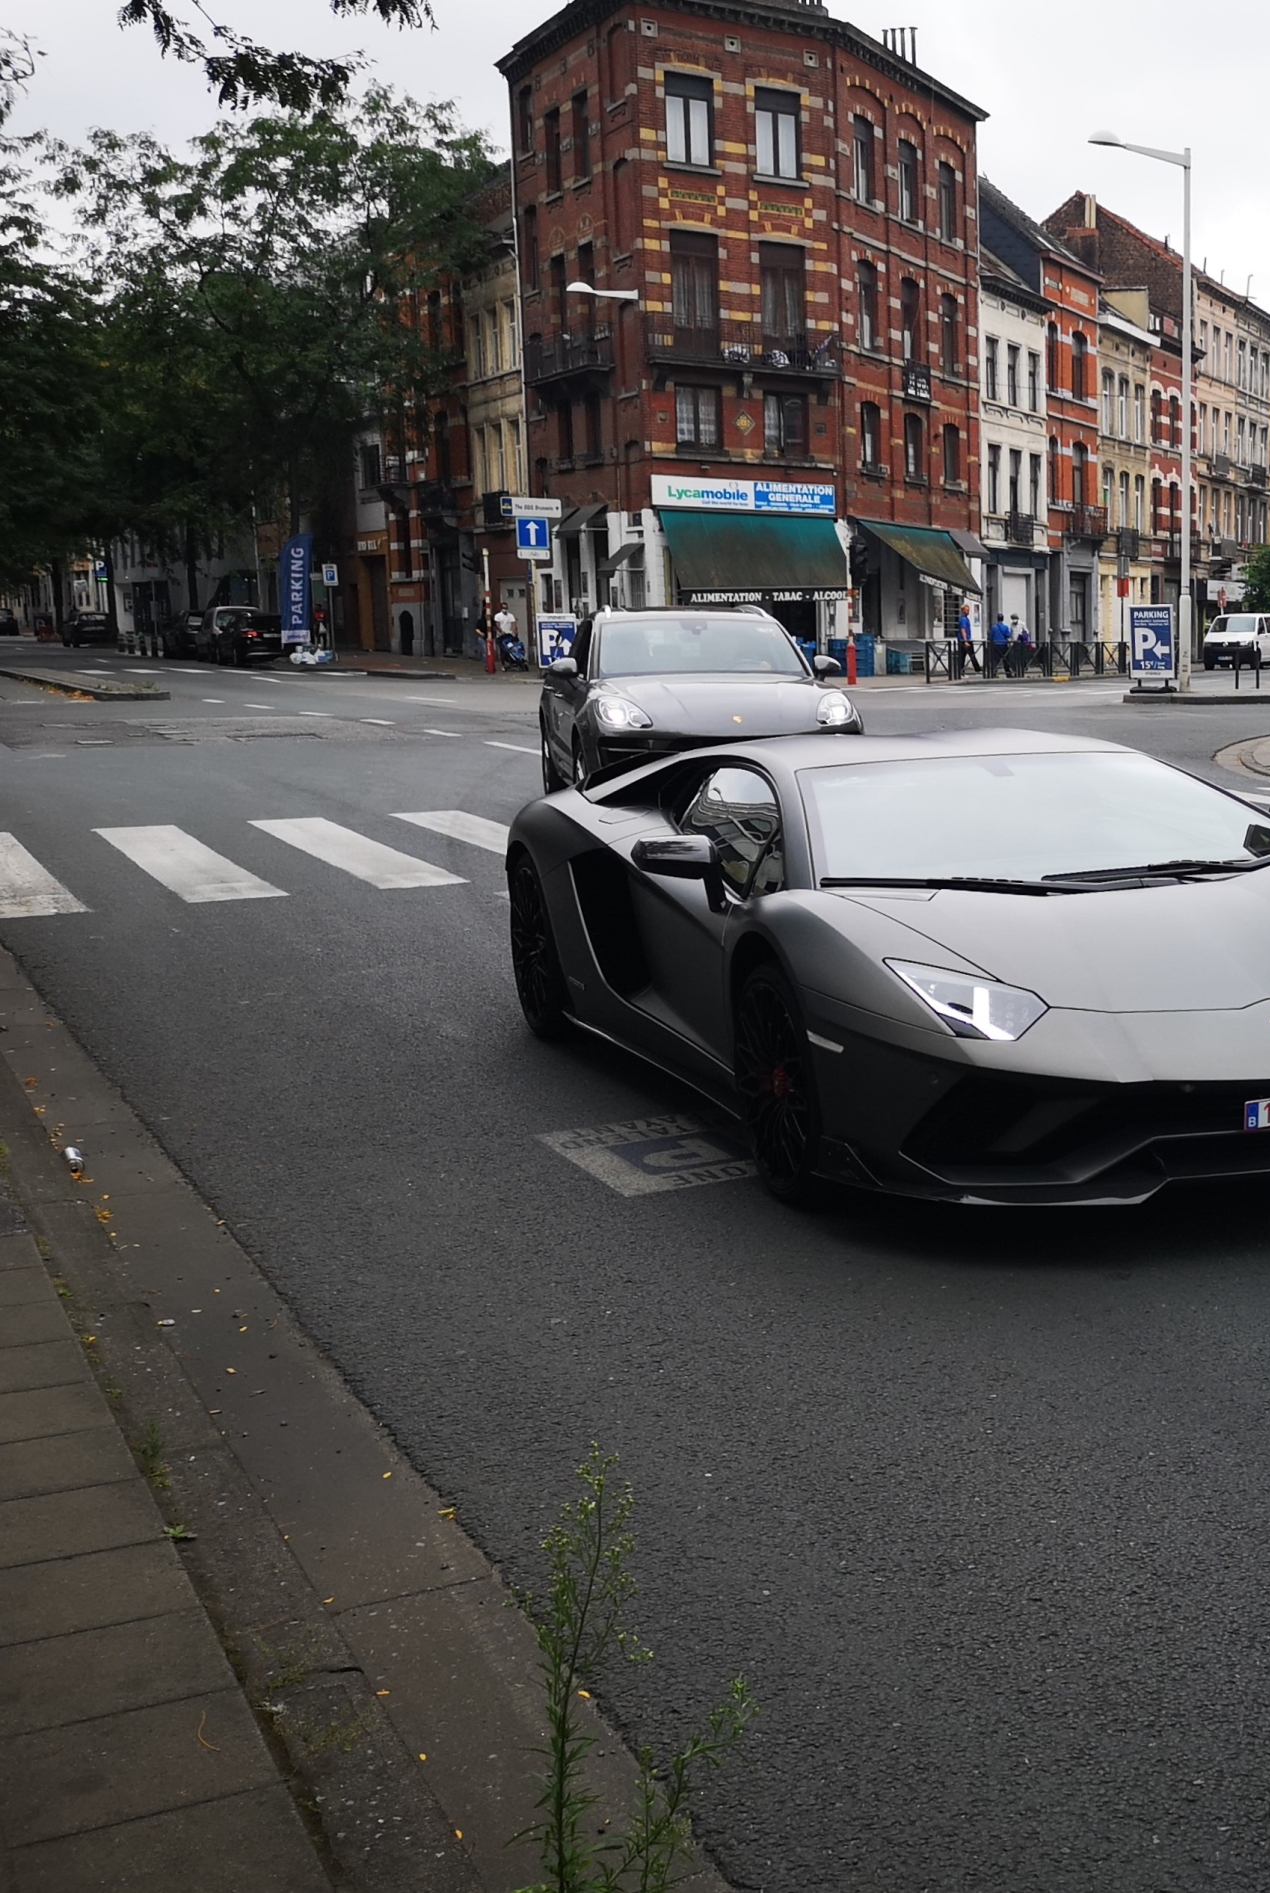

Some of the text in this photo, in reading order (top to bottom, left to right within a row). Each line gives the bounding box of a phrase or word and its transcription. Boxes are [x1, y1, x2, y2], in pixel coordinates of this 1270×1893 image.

[667, 484, 749, 502] Lycamobile
[756, 482, 833, 496] ALIMENTATION
[768, 493, 821, 504] GENERALE
[95, 560, 105, 571] P
[290, 547, 305, 625] PARKING
[690, 591, 762, 603] ALIMENTATION
[772, 591, 803, 601] TABAC
[1133, 610, 1169, 619] PARKING
[1134, 627, 1157, 661] P
[1247, 1116, 1258, 1128] B
